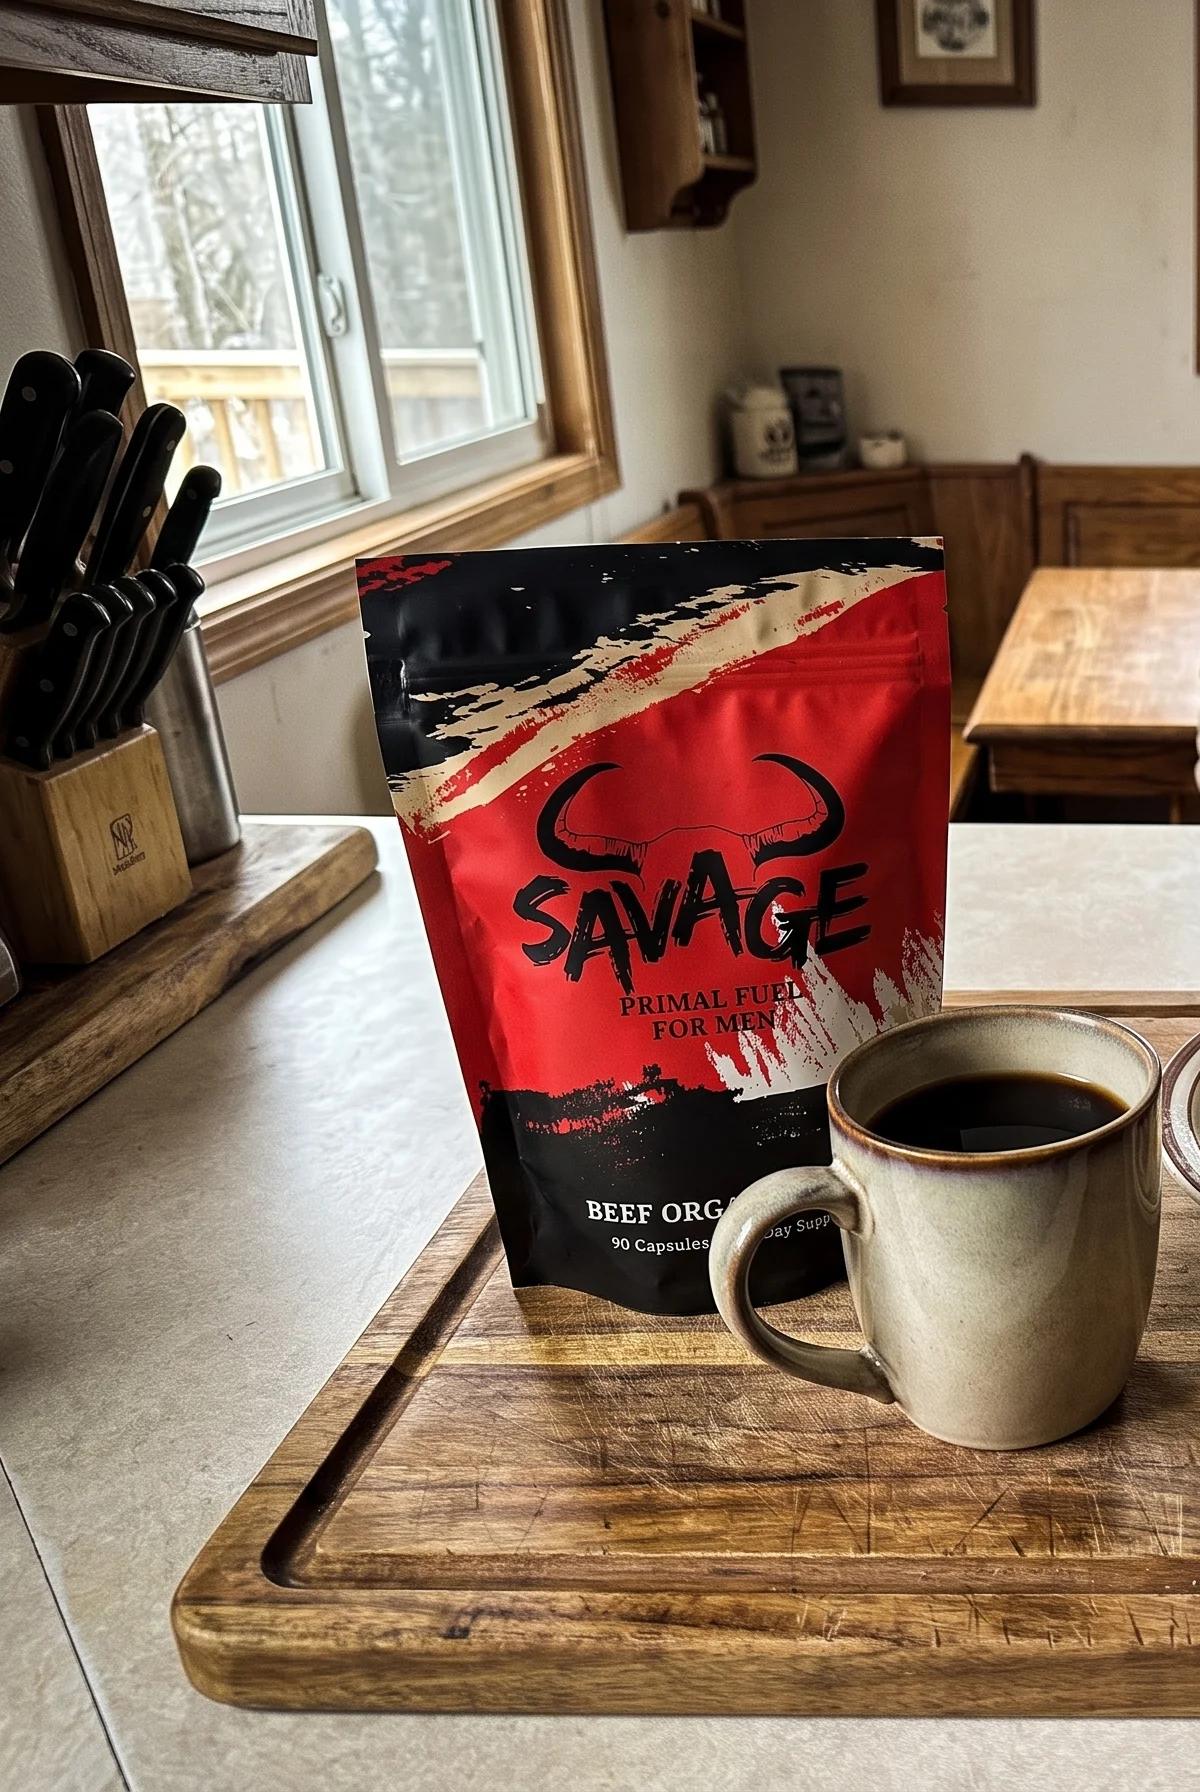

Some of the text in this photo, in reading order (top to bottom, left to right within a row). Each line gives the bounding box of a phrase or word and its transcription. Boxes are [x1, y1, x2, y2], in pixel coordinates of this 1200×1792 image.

[513, 849, 872, 993] SAVAGE
[619, 980, 802, 1016] PRIMAL FUEL
[652, 1009, 776, 1040] FOR MEN
[586, 1197, 736, 1224] BEEF ORG
[611, 1236, 631, 1250] 90
[634, 1237, 710, 1255] Capsules
[796, 1214, 831, 1232] Supp
